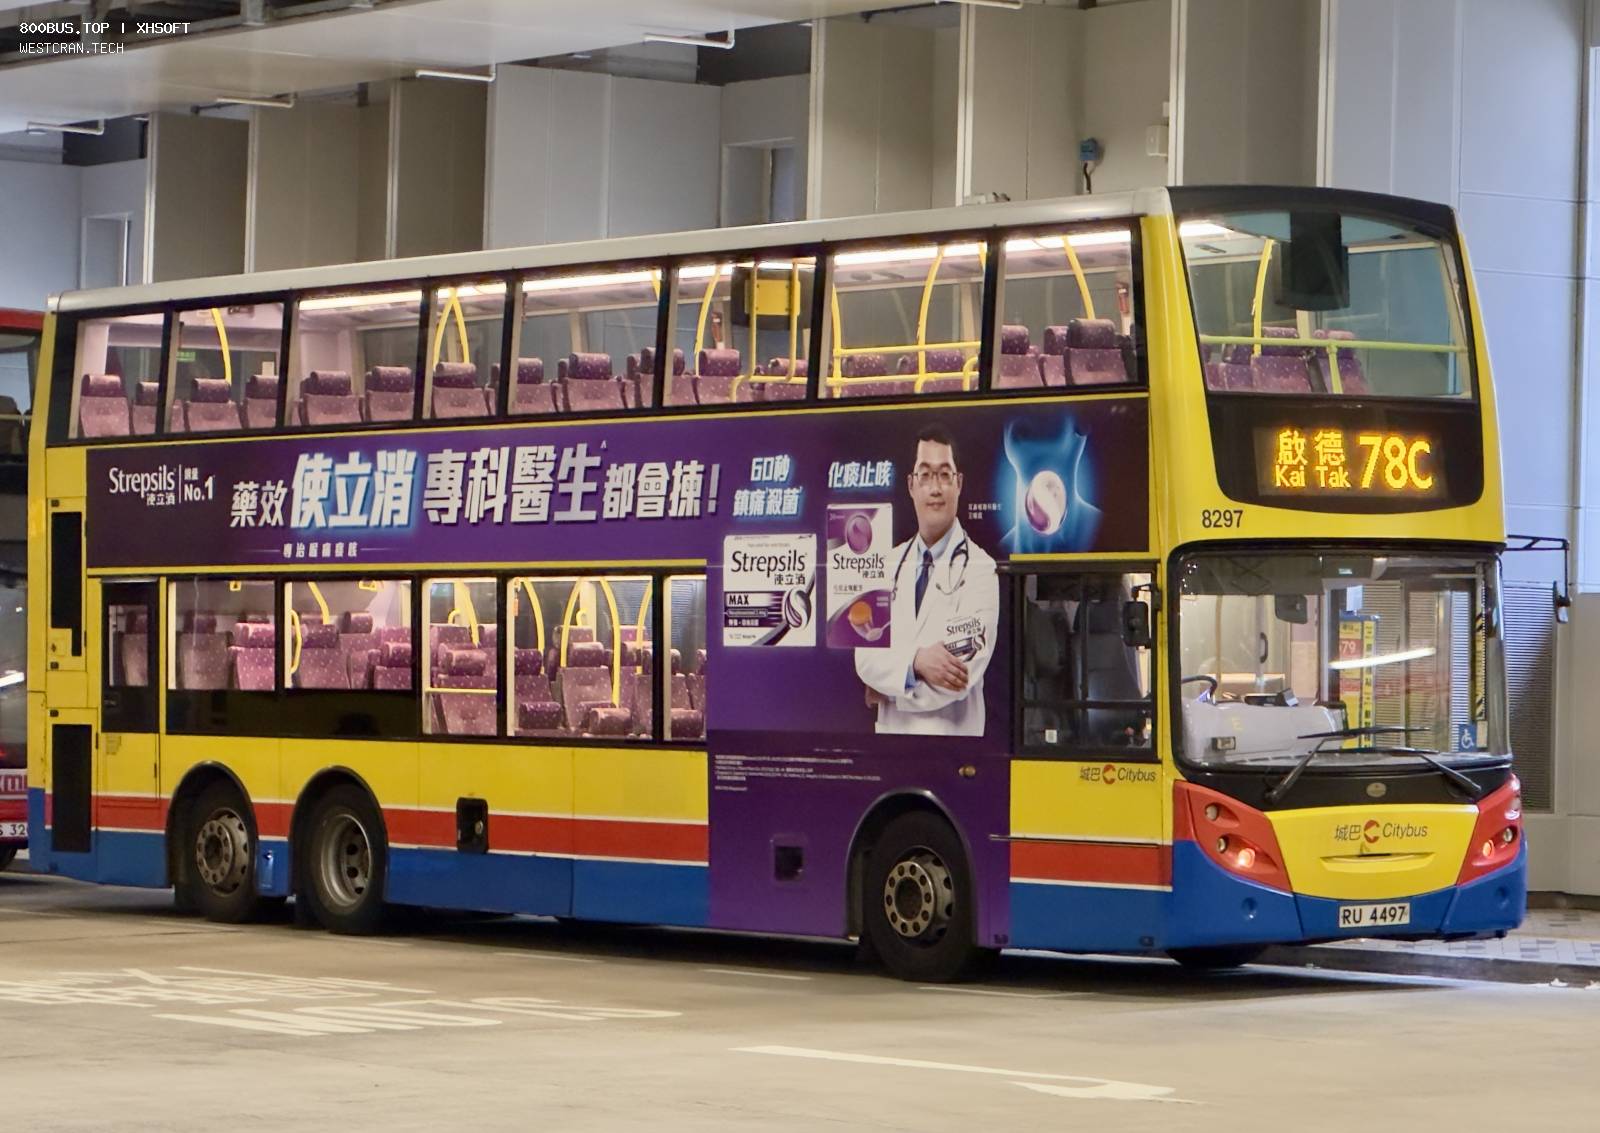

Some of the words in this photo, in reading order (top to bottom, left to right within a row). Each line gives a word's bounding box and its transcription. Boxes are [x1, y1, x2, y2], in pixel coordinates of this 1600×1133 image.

[750, 454, 791, 482] 60秒
[1359, 434, 1433, 490] 78C
[109, 464, 175, 499] Strepsils
[828, 460, 893, 488] 化痰止咳
[1275, 464, 1306, 487] Kai
[1315, 466, 1352, 488] Tak
[184, 475, 214, 501] No.1
[1201, 509, 1244, 529] 8297
[731, 550, 806, 578] Strepsils
[832, 553, 886, 573] Strepsils
[728, 595, 750, 606] MAX
[1117, 767, 1157, 782] Citybus
[1334, 824, 1362, 841] 城巴
[1382, 822, 1429, 840] Citybus
[1342, 908, 1363, 925] RU
[1370, 905, 1407, 923] 4497
